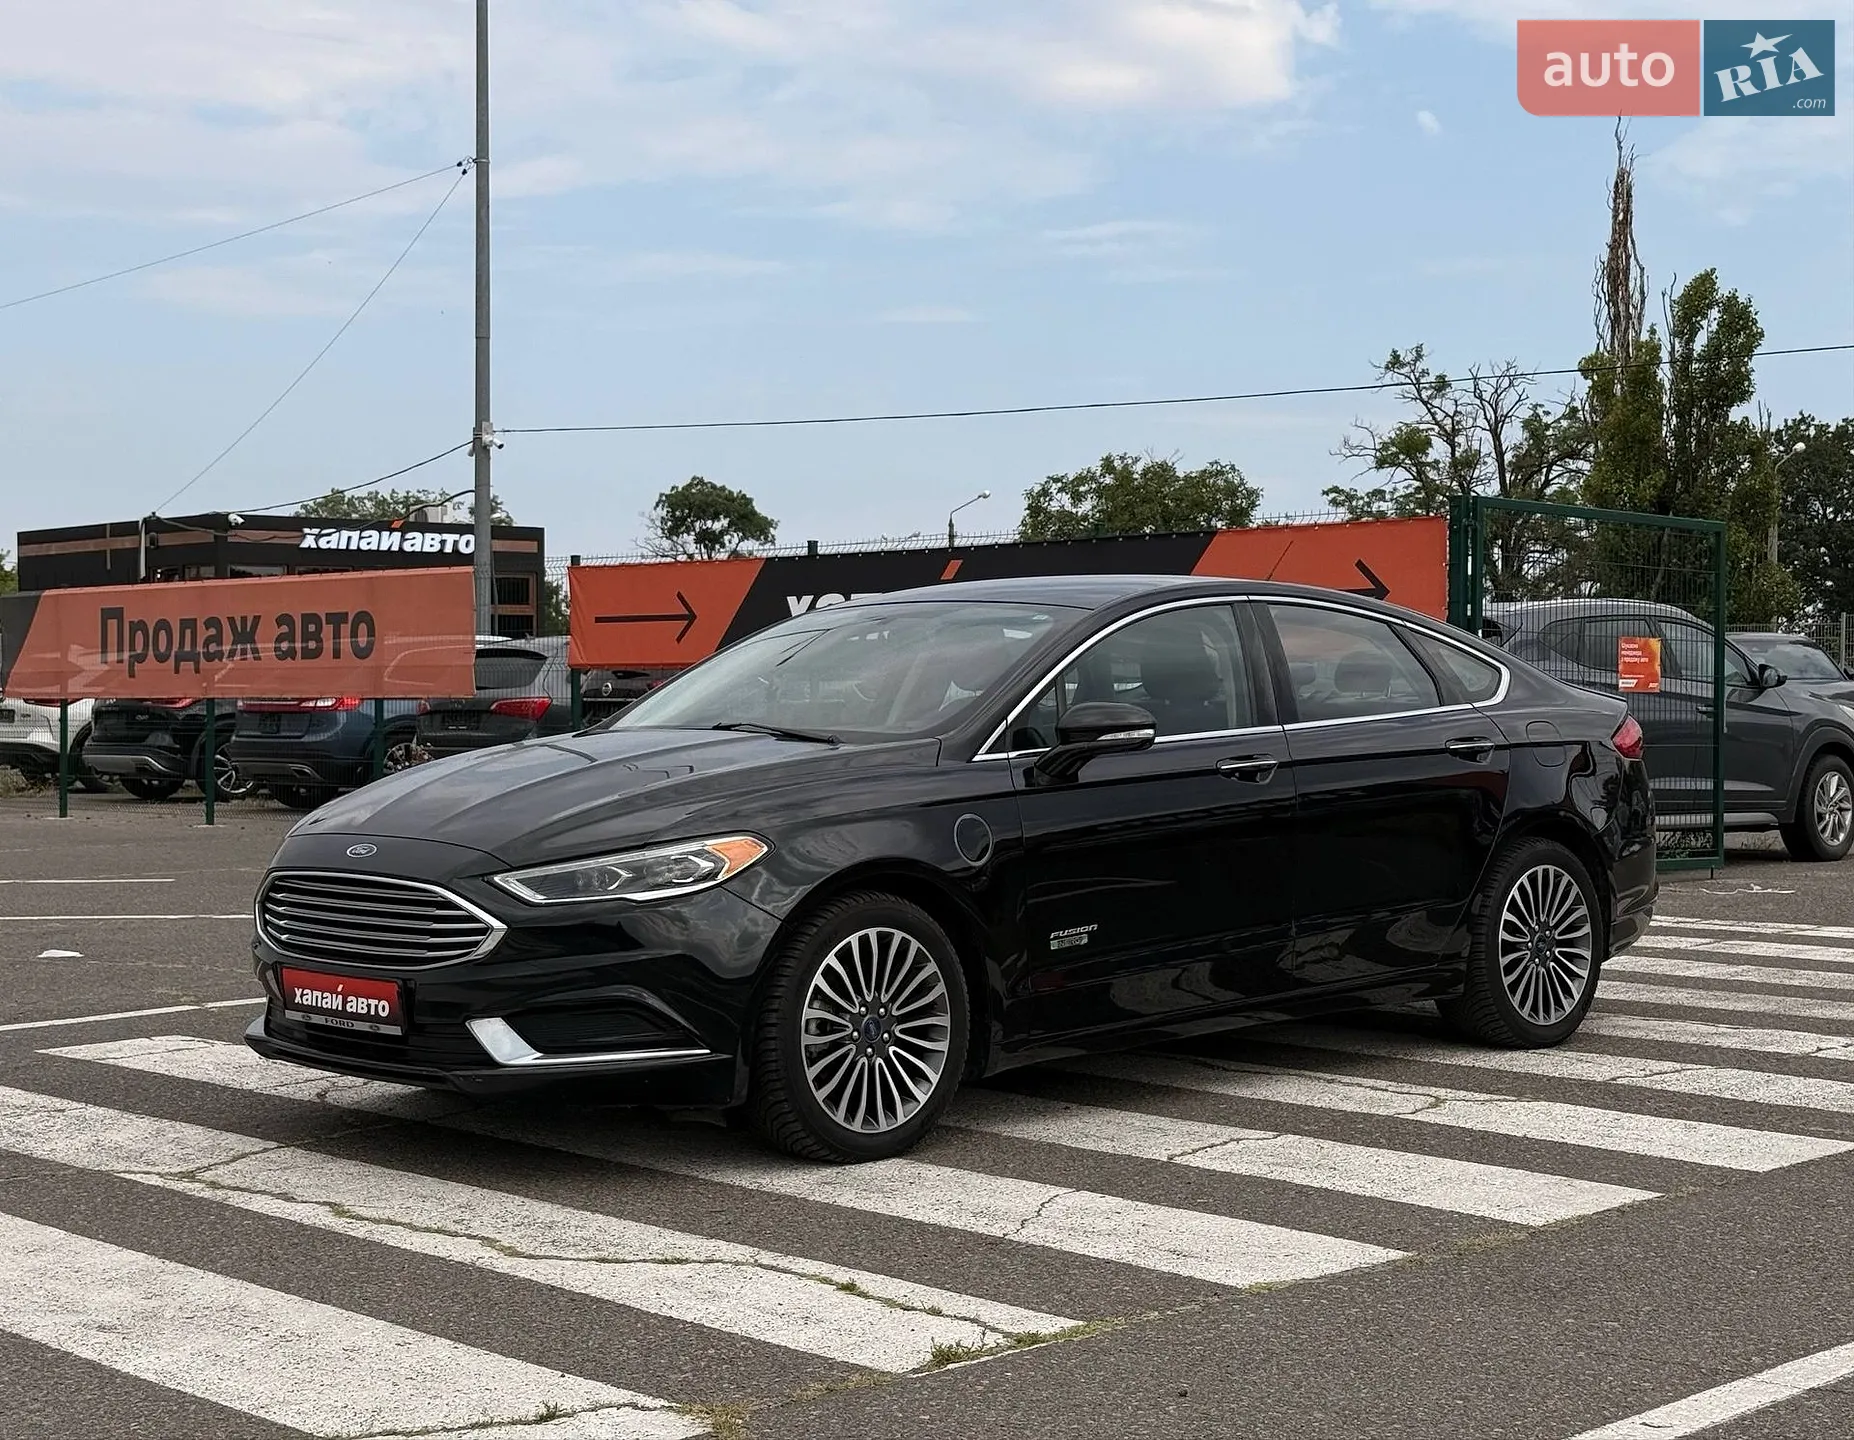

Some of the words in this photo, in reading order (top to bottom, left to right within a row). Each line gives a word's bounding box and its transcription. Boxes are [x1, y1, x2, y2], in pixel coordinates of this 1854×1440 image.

[99, 606, 262, 678] Продаж
[273, 610, 376, 661] авто
[345, 995, 390, 1018] авто
[324, 1017, 355, 1028] FORD
